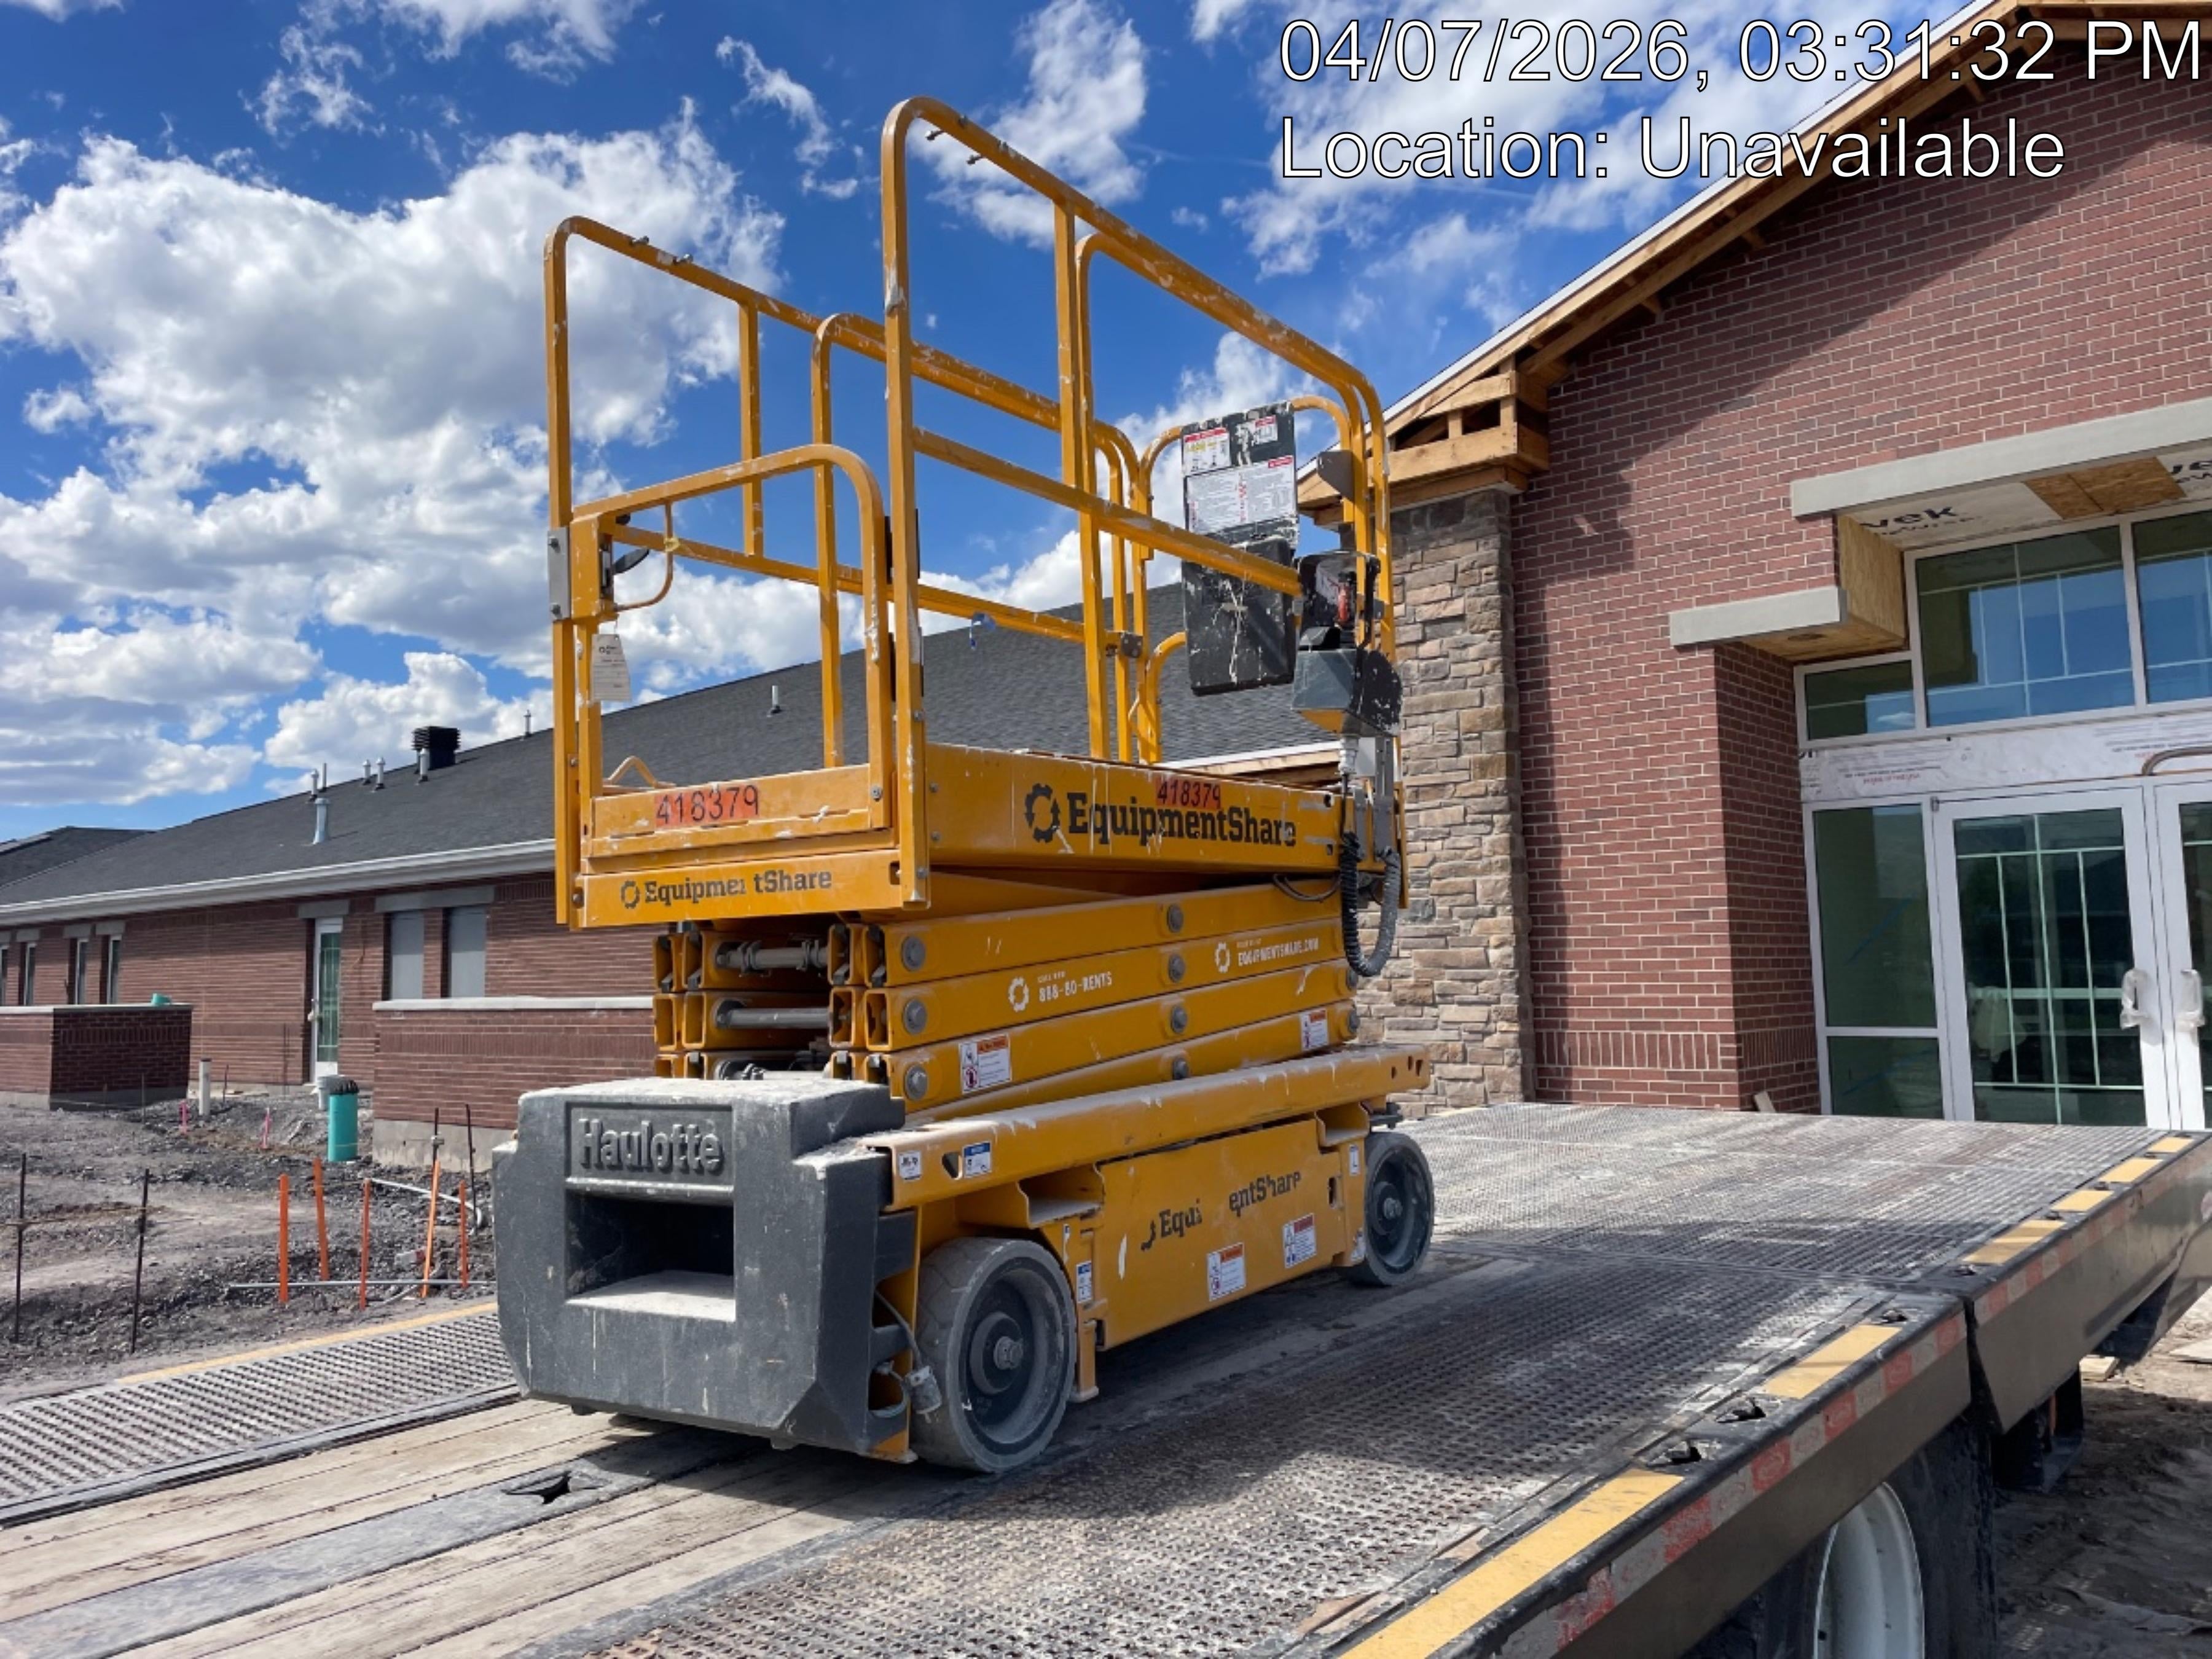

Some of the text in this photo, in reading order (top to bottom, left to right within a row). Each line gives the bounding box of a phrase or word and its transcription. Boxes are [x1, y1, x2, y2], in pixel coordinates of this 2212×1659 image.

[656, 784, 759, 824] 418379
[1158, 780, 1221, 809] 418379
[1067, 792, 1296, 847] EquipmentShare
[578, 1118, 723, 1174] Haulotte
